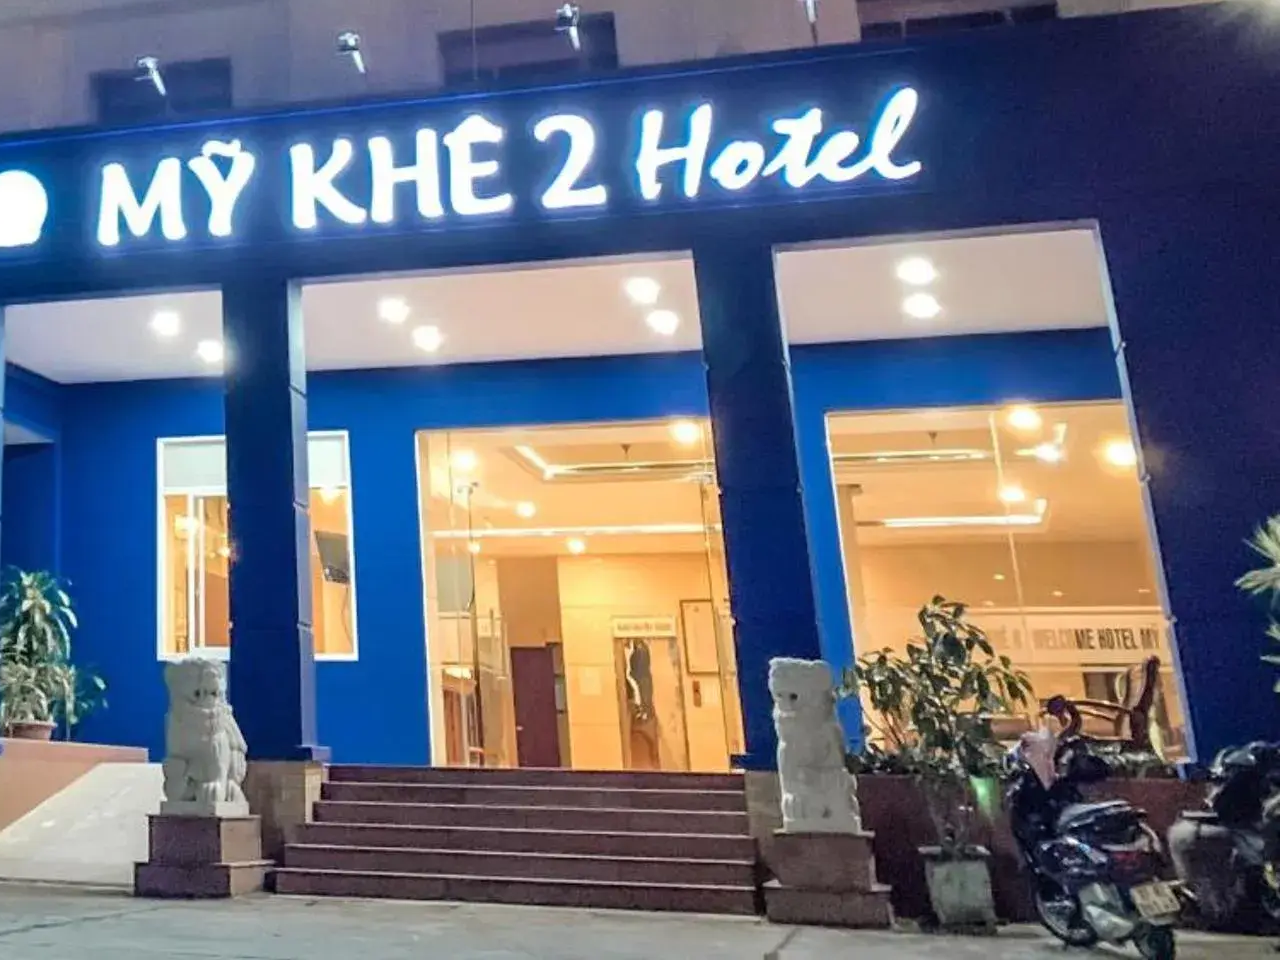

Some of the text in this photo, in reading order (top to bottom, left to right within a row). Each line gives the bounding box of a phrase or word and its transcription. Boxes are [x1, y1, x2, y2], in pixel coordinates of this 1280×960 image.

[96, 86, 922, 246] MỸ KHÊ 2 Hotel
[1097, 627, 1138, 650] HOTEL
